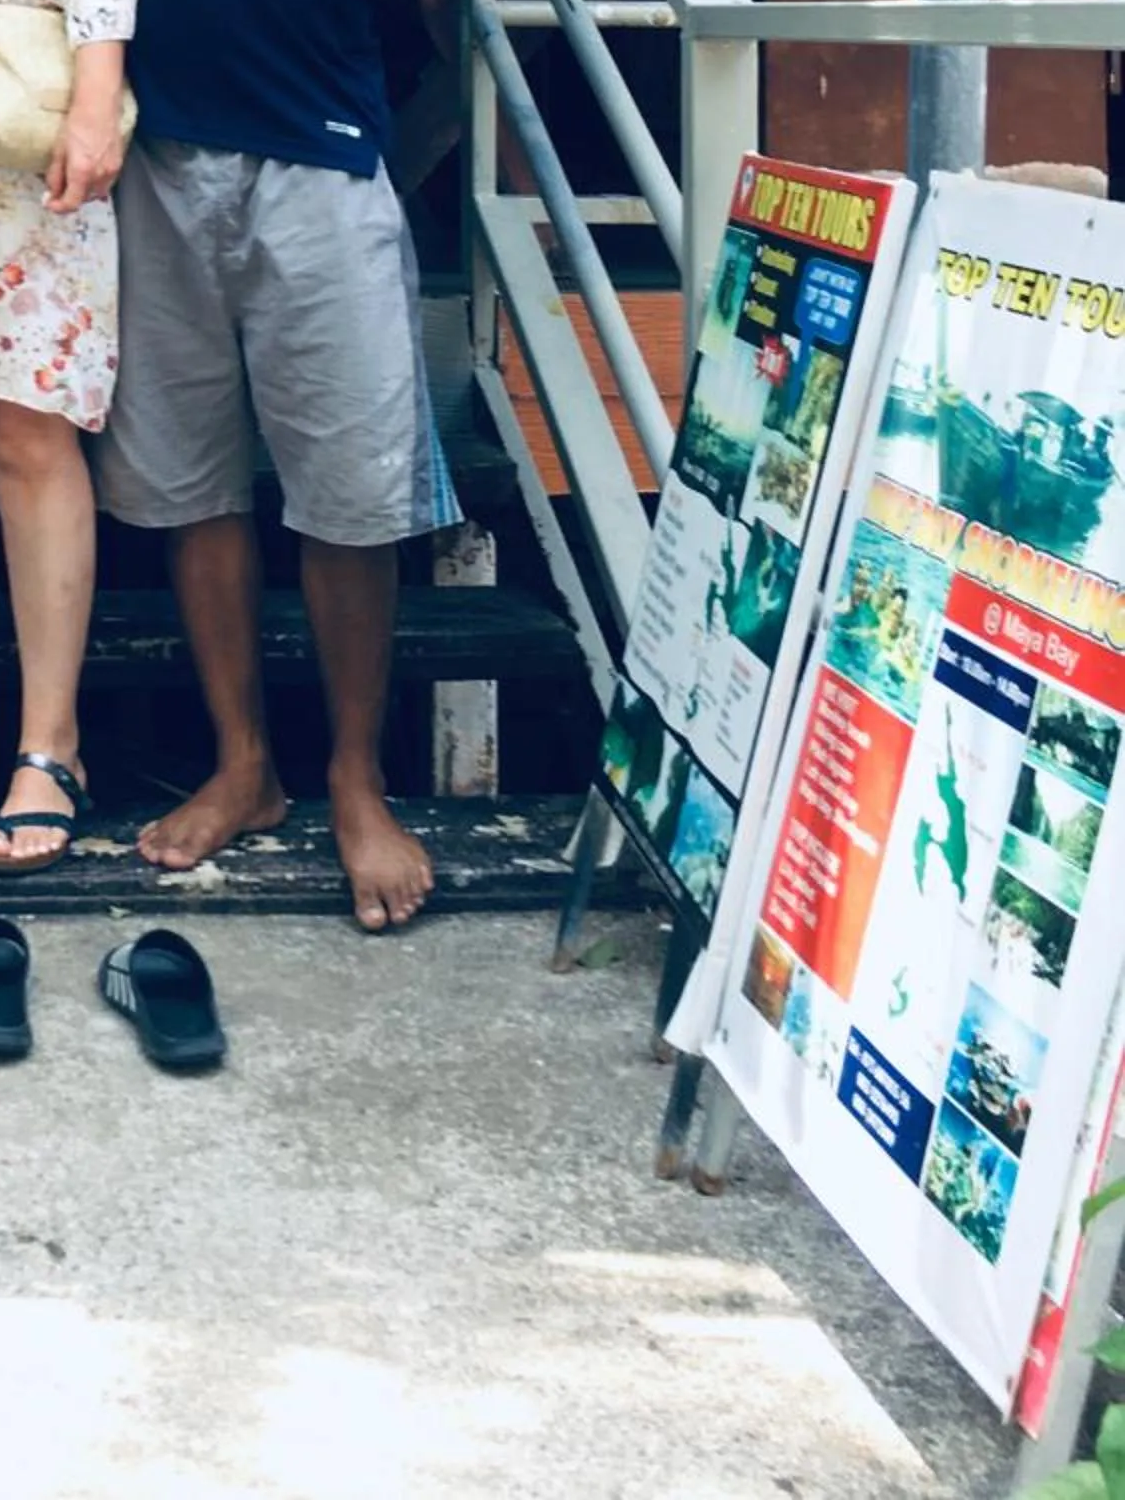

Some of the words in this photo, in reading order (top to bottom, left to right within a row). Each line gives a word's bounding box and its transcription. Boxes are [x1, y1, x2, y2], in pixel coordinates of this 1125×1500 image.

[750, 172, 785, 224] TOP
[779, 181, 817, 235] TEN
[811, 188, 877, 252] TOURS
[935, 247, 991, 301] TOP
[991, 262, 1061, 321] TEN
[1002, 611, 1044, 654] Maya
[1045, 631, 1081, 676] Bay
